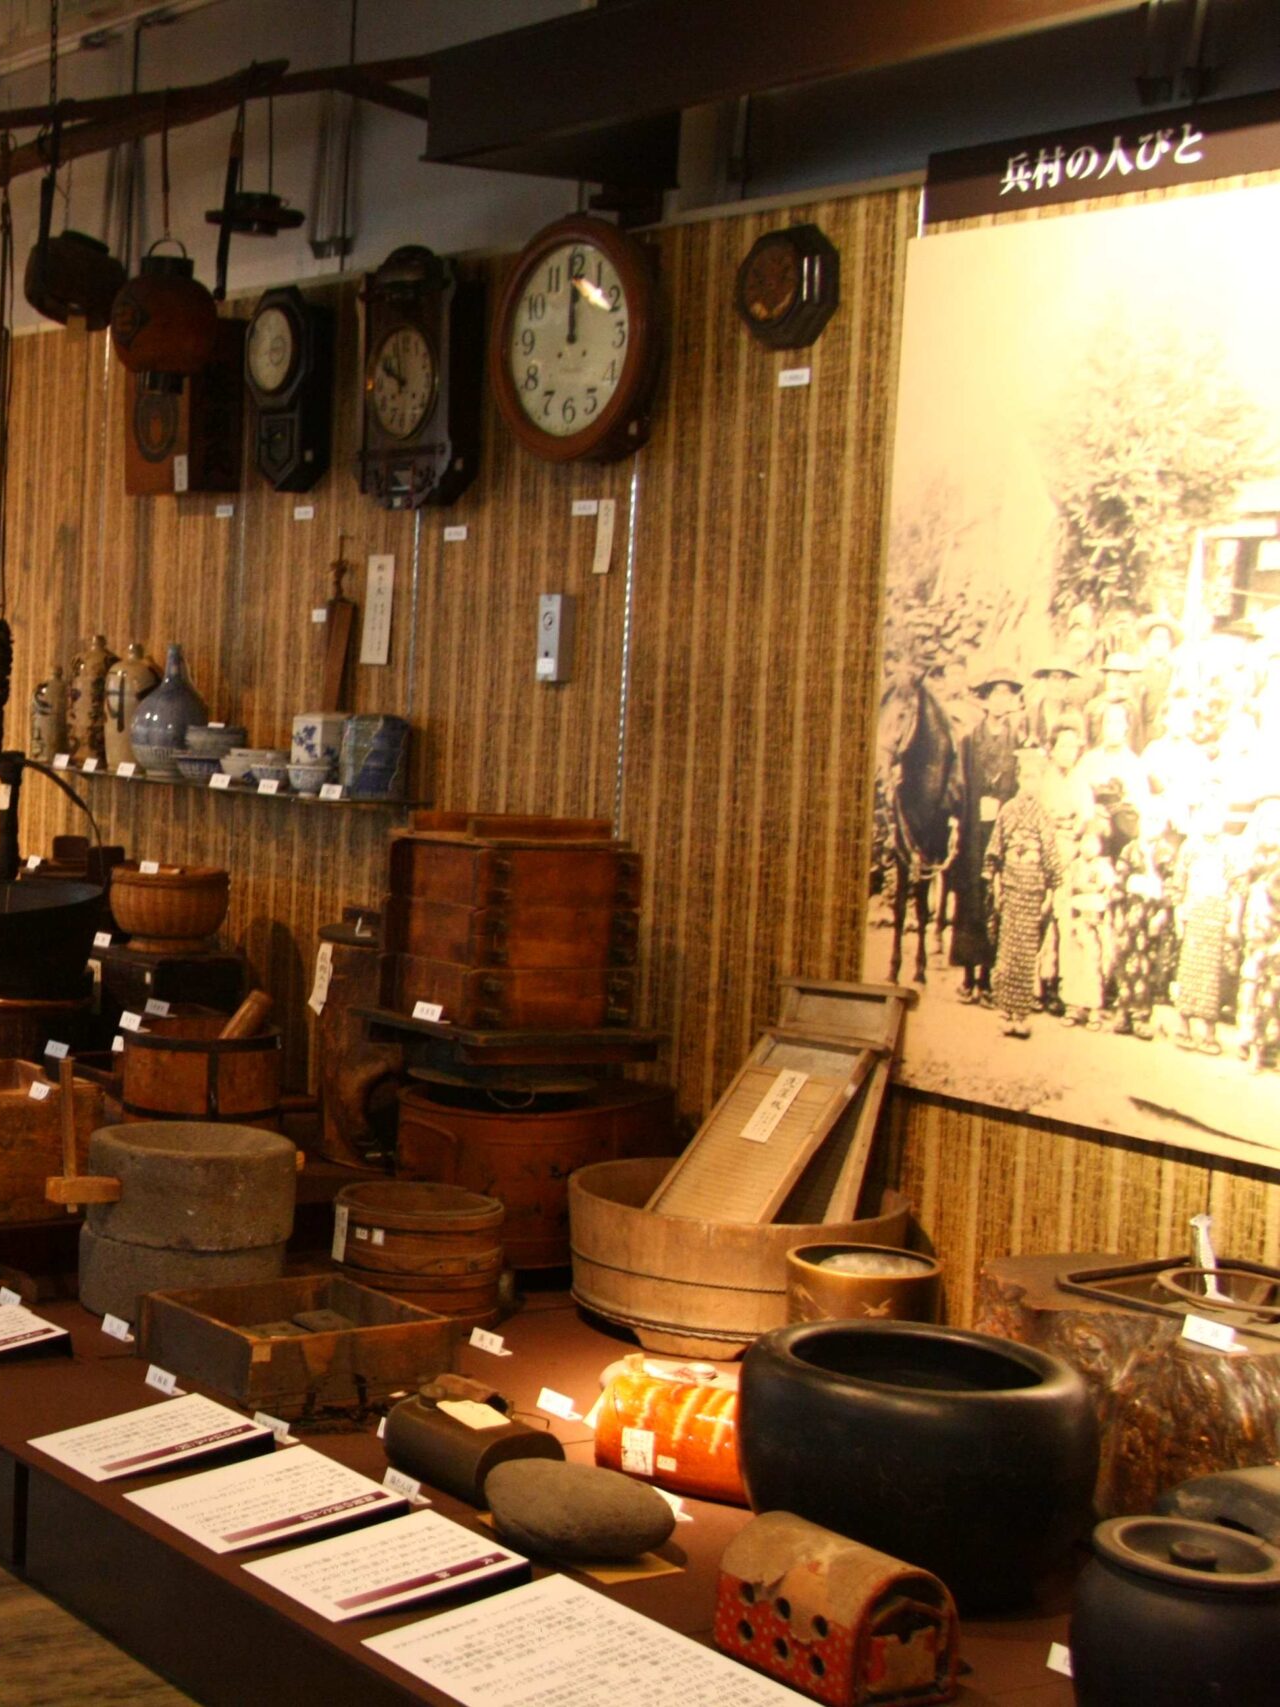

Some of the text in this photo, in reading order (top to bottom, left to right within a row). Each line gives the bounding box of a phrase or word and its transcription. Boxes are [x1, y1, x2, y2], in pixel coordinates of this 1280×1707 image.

[999, 123, 1203, 196] 兵村の人びと
[528, 295, 546, 321] 10
[522, 329, 536, 355] 9
[612, 322, 626, 349] 3
[524, 365, 538, 391] 8
[542, 391, 556, 417] 7
[562, 397, 576, 424] 6
[584, 387, 598, 414] 5
